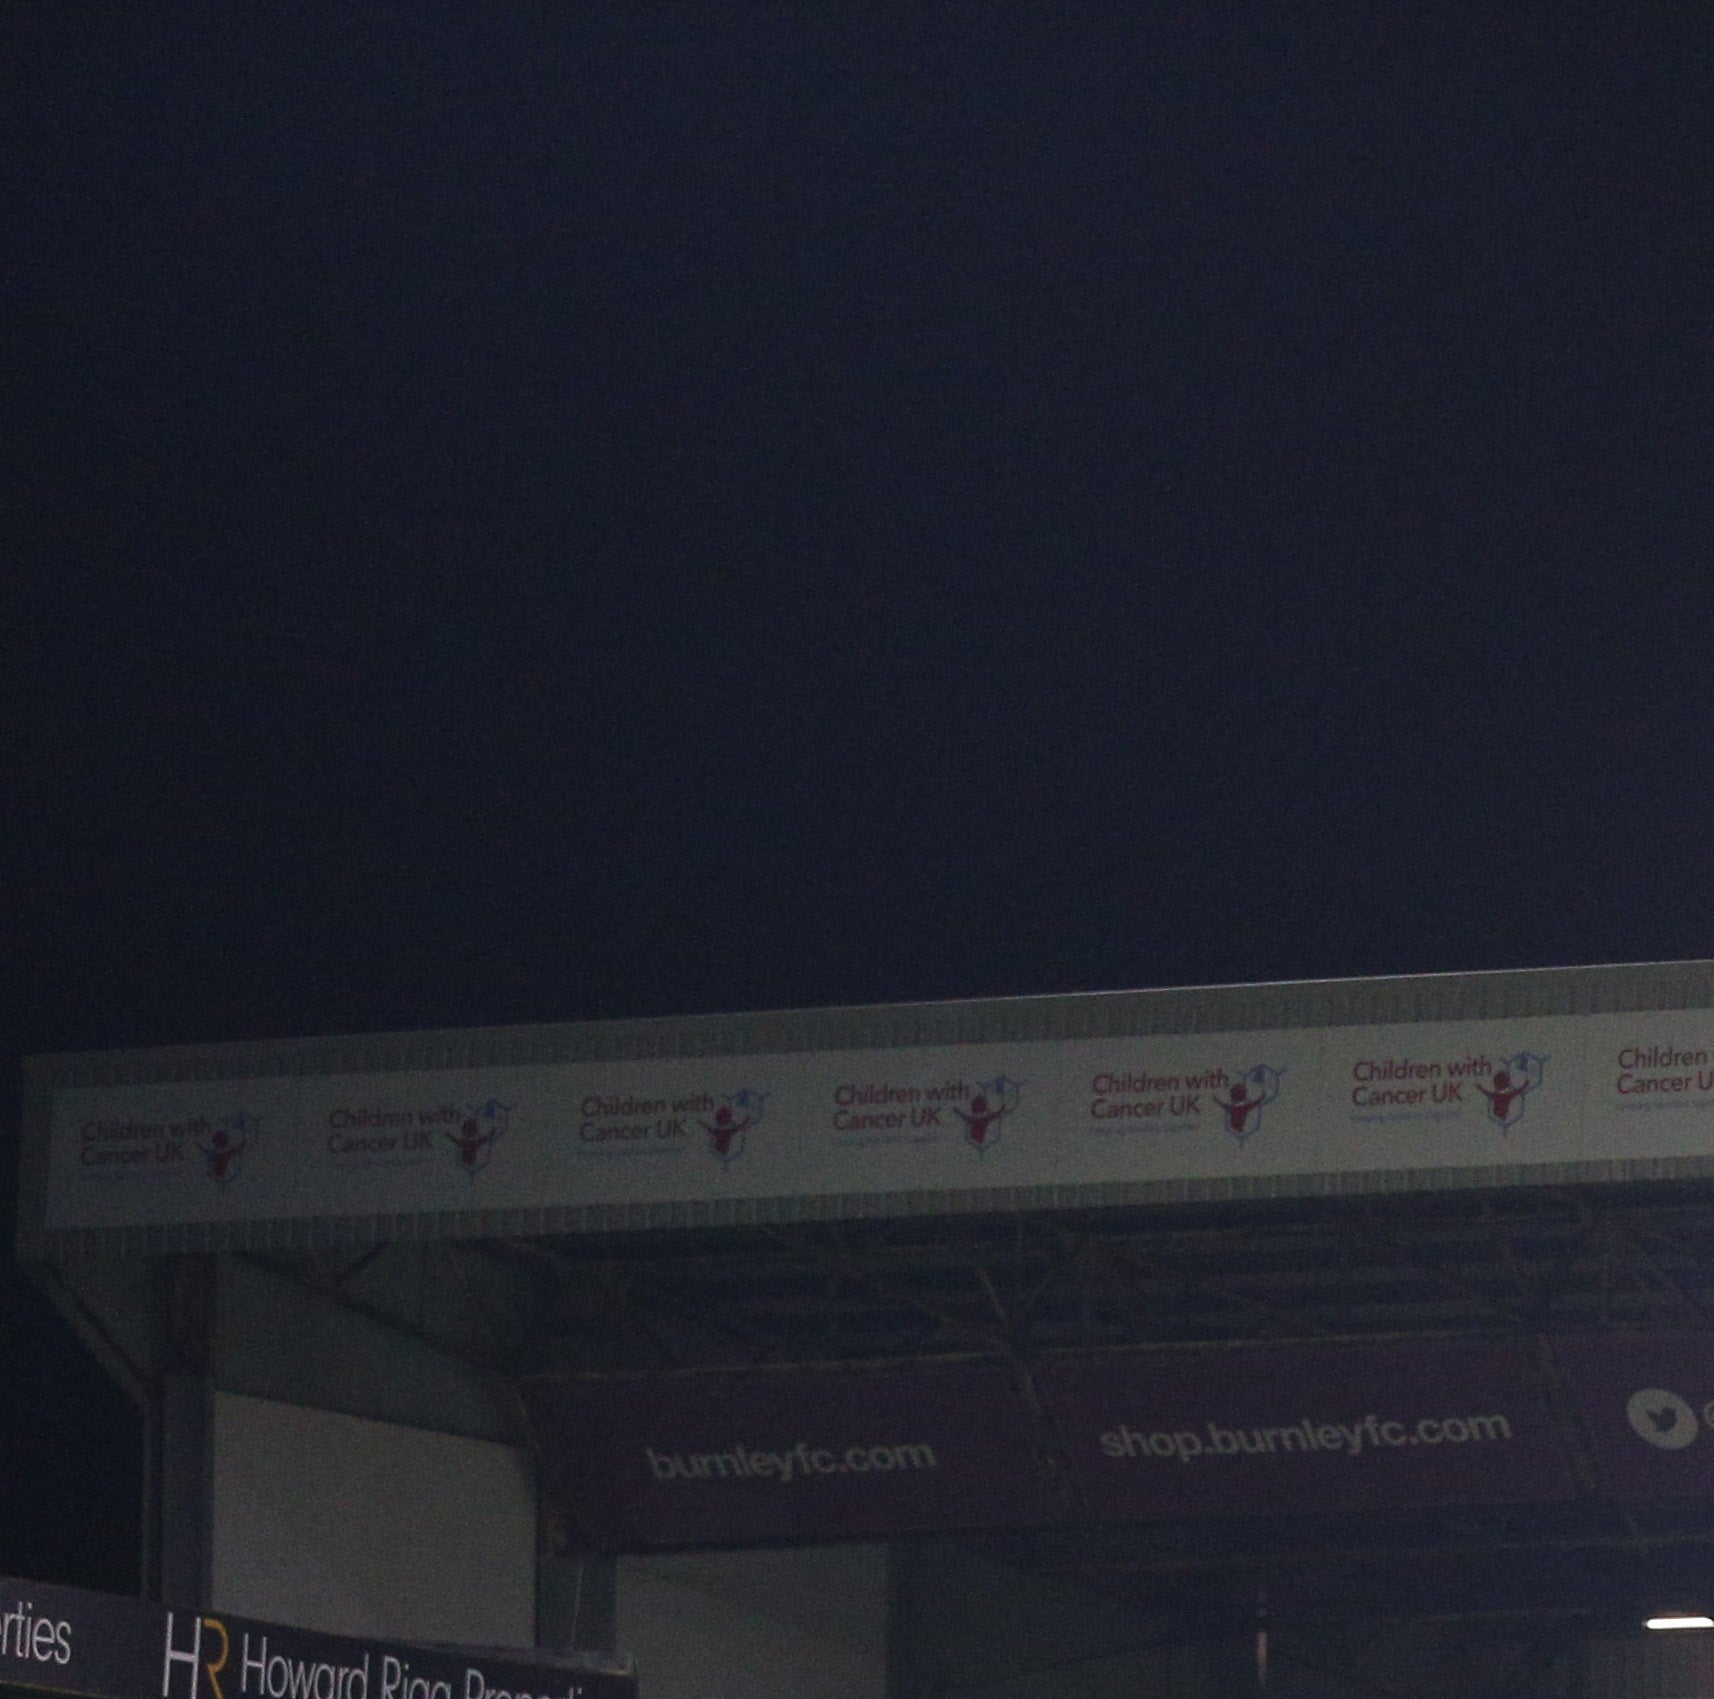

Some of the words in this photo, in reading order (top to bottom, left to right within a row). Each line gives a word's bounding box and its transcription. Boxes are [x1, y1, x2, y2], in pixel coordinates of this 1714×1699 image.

[1352, 1058, 1443, 1082] Children
[1446, 1055, 1493, 1077] with
[1617, 1046, 1709, 1069] Children
[1092, 1071, 1181, 1095] Children
[1184, 1068, 1231, 1090] with
[1351, 1086, 1428, 1106] Cancer
[1431, 1081, 1464, 1103] UK
[1616, 1073, 1694, 1094] Cancer
[1090, 1099, 1166, 1119] Cancer
[1169, 1093, 1202, 1115] UK
[1100, 1408, 1512, 1464] shop.burnleyfc.com
[646, 1438, 937, 1483] burnleyfc.com
